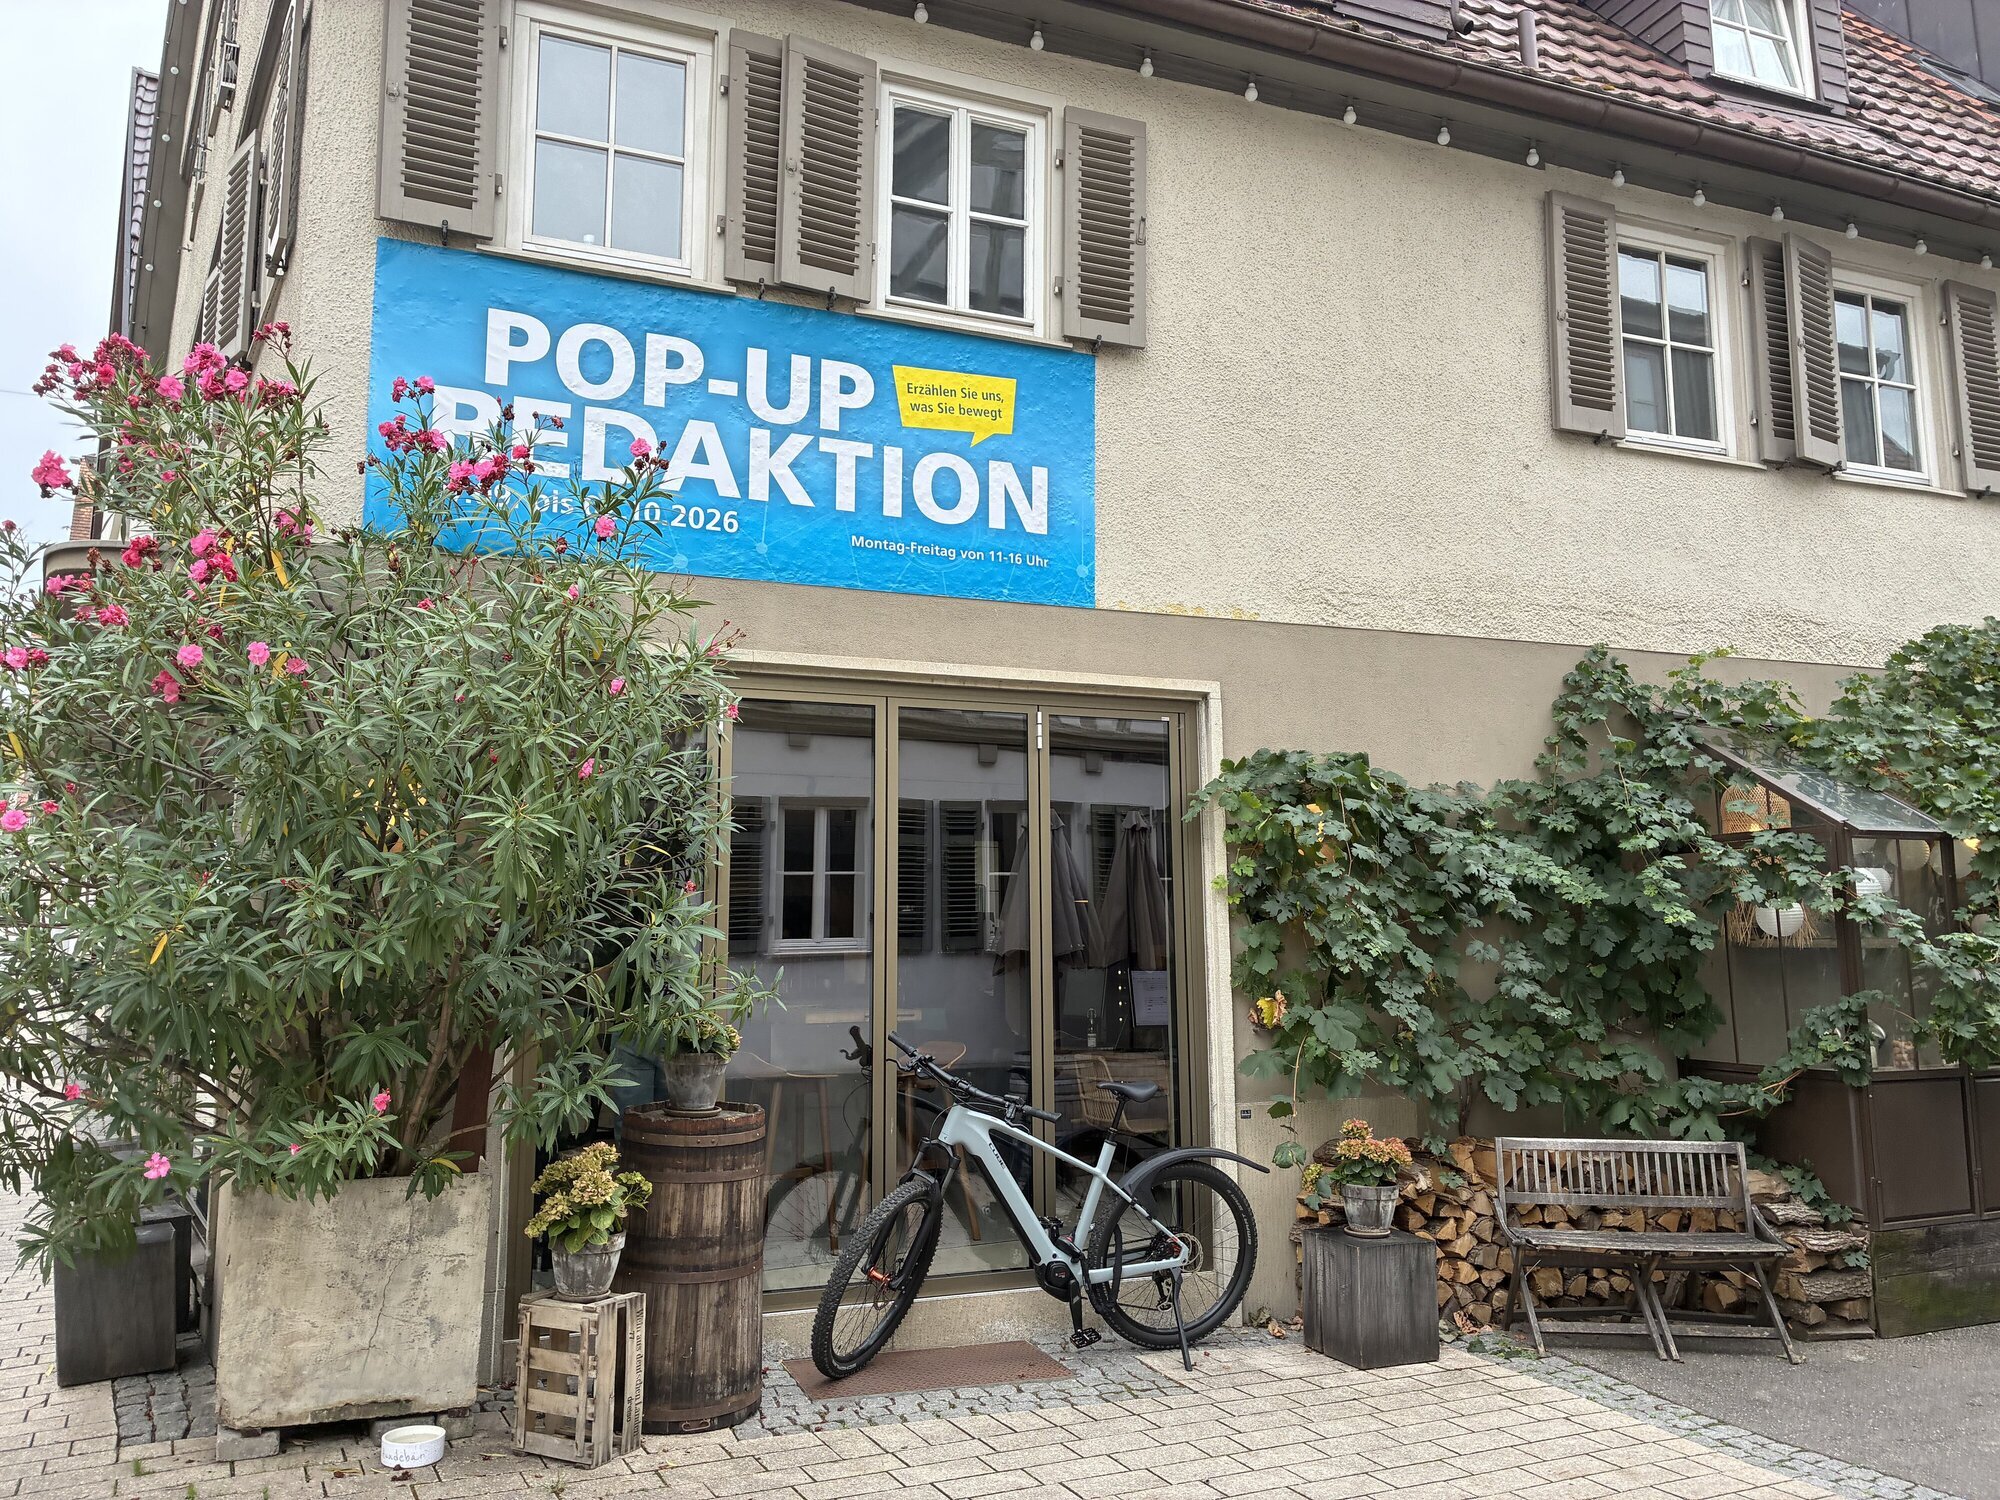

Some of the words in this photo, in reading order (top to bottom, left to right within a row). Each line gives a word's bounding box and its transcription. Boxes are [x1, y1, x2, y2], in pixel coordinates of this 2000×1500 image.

[484, 307, 876, 432] POP-UP
[906, 382, 957, 398] Erzählen
[960, 387, 978, 399] Sie
[981, 391, 1005, 403] uns,
[910, 403, 934, 413] was
[937, 402, 955, 415] Sie
[958, 402, 1003, 421] bewegt
[432, 384, 1048, 535] REDAKTION
[851, 534, 956, 560] Montag-Freitag
[960, 549, 985, 561] von
[989, 550, 1023, 565] 11-16
[1026, 554, 1049, 568] Uhr
